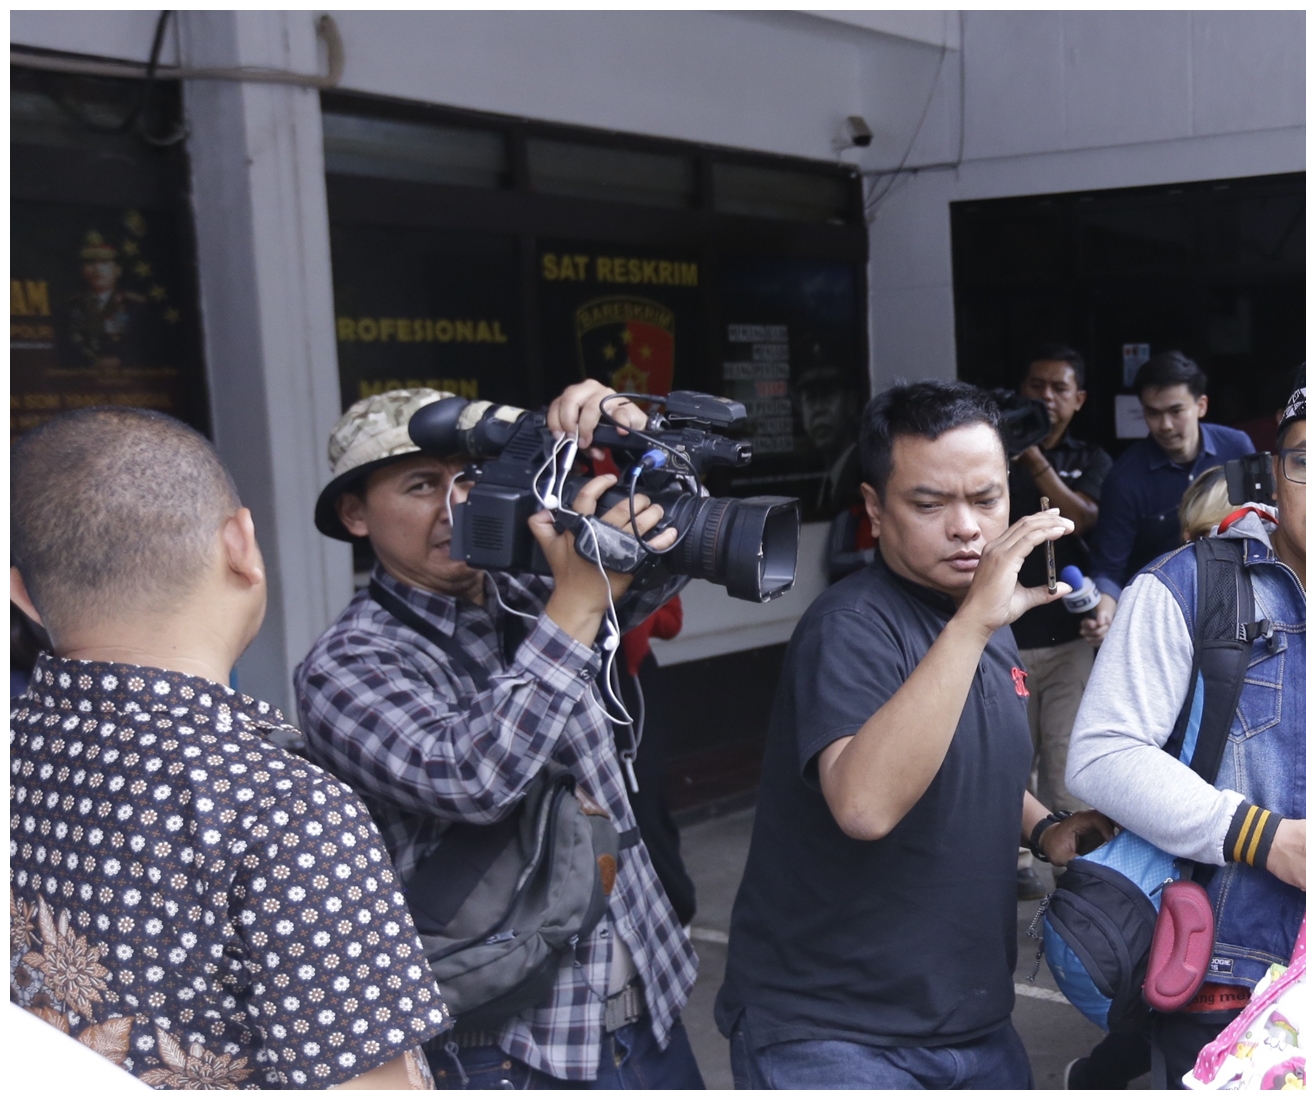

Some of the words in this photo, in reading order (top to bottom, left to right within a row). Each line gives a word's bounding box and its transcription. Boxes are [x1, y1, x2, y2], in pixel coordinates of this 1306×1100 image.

[543, 254, 590, 281] SAT
[597, 257, 698, 287] RESKRIM
[579, 302, 672, 328] BARESKRIM
